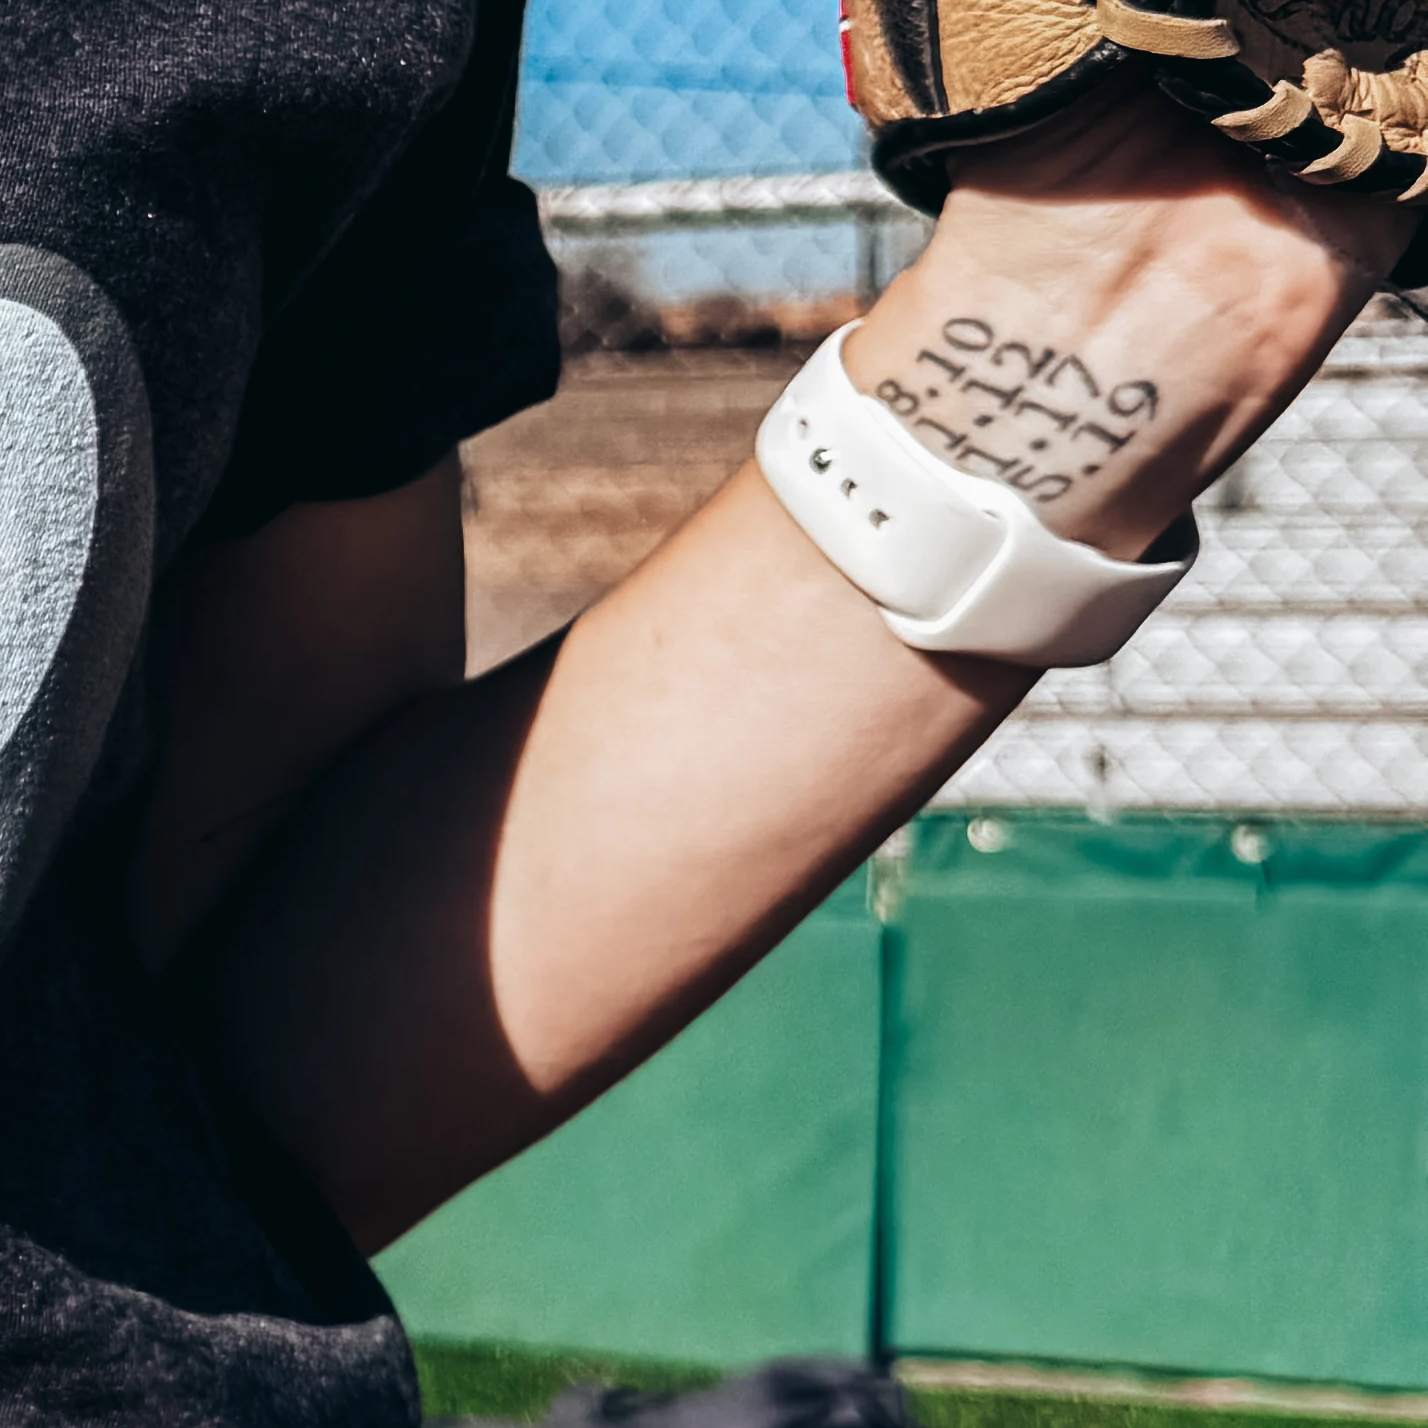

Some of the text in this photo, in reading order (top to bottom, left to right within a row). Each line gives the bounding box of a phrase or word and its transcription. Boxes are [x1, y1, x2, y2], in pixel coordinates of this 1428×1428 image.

[875, 317, 996, 417] 8.10
[913, 340, 1057, 451] 1.12
[955, 353, 1101, 474] 1.17
[1008, 378, 1160, 504] 5.19
